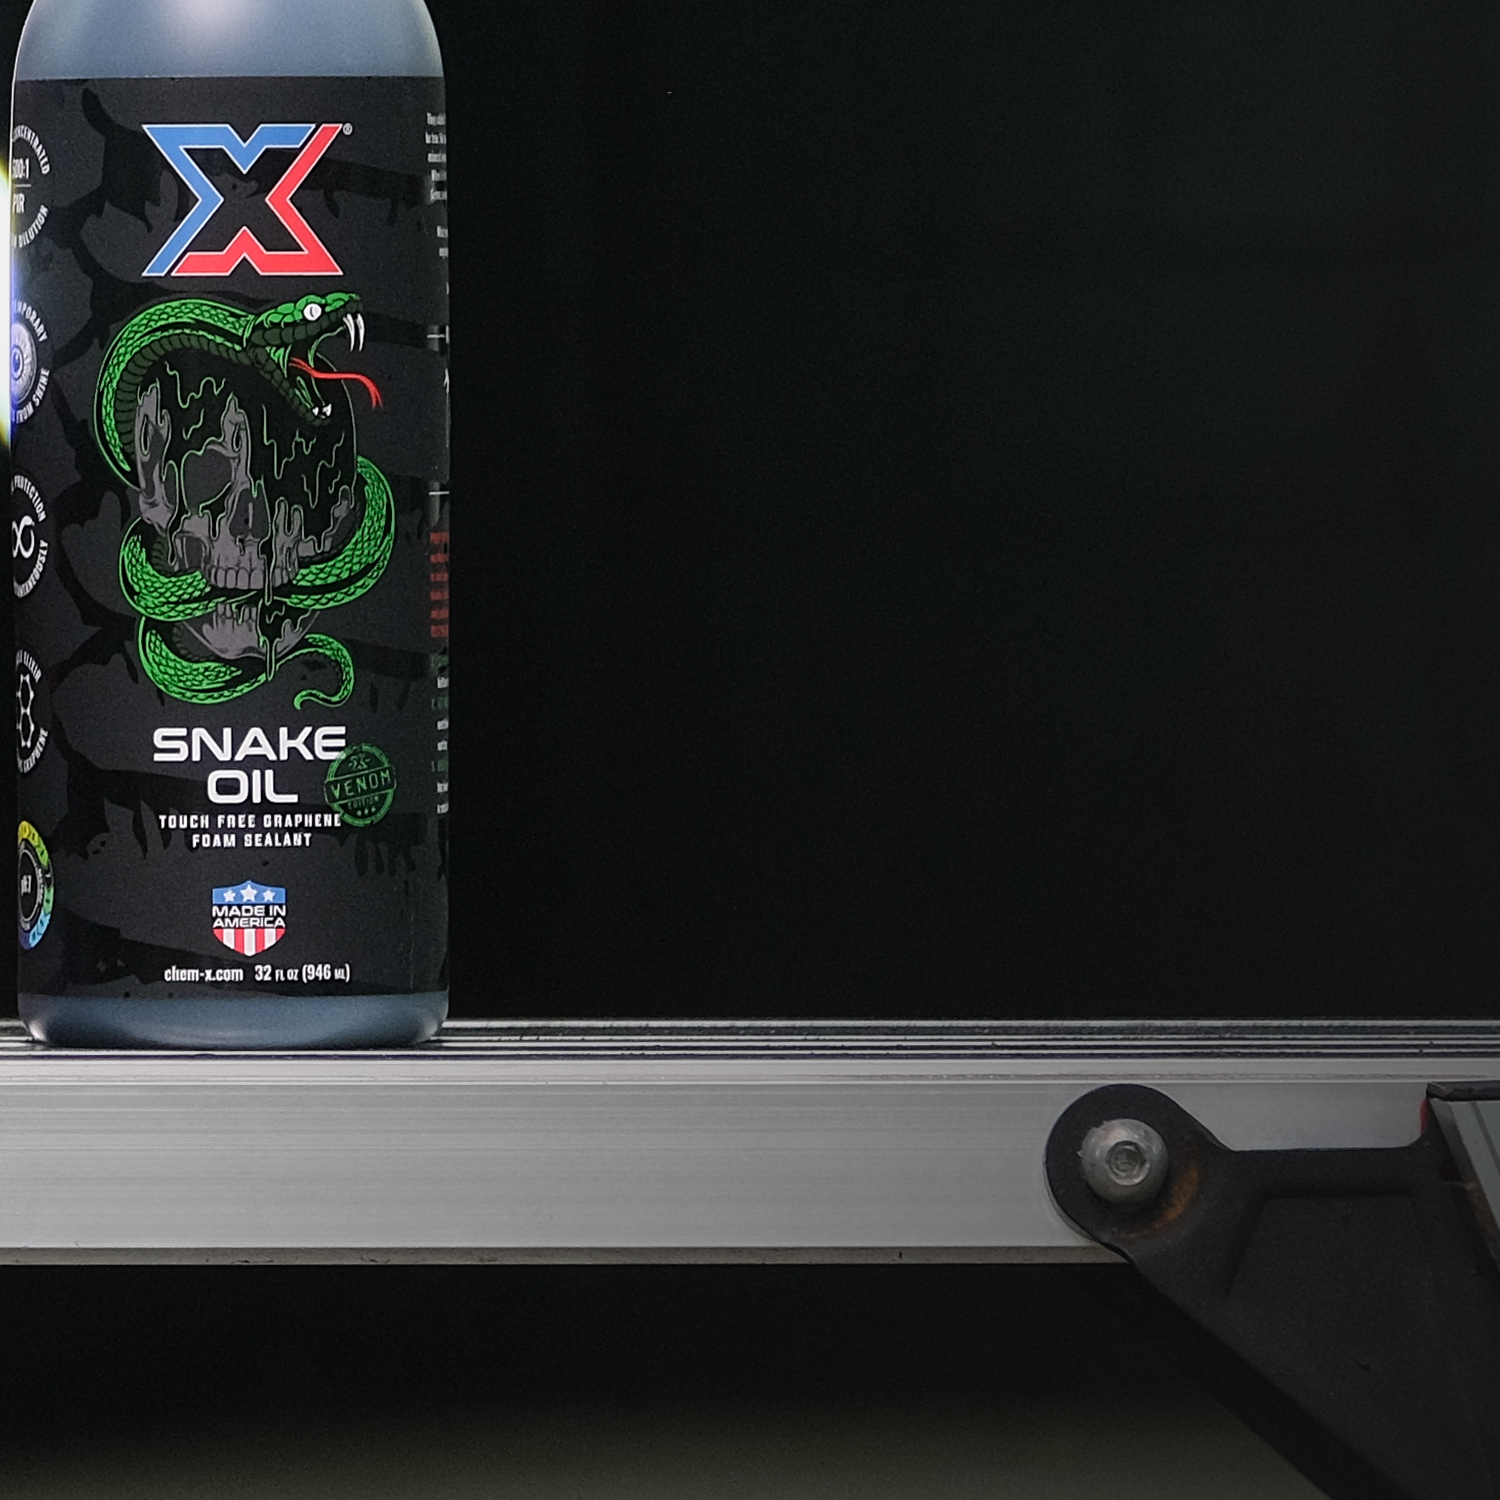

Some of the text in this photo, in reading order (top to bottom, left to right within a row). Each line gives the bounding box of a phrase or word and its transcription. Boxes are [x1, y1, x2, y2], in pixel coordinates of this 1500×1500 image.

[32, 367, 50, 407] SHINE
[153, 726, 346, 762] SNAKE
[207, 769, 298, 804] OIL
[330, 769, 391, 799] VENOM
[159, 813, 341, 829] TOUCH FREE GRAPHENE
[192, 833, 312, 848] FOAM SEALANT
[212, 905, 286, 916] MADE IN
[212, 917, 286, 928] AMERICA
[164, 965, 243, 981] chem-x.com
[254, 965, 272, 981] 32
[275, 970, 285, 981] FL
[287, 970, 298, 981] OZ
[302, 964, 331, 983] (946
